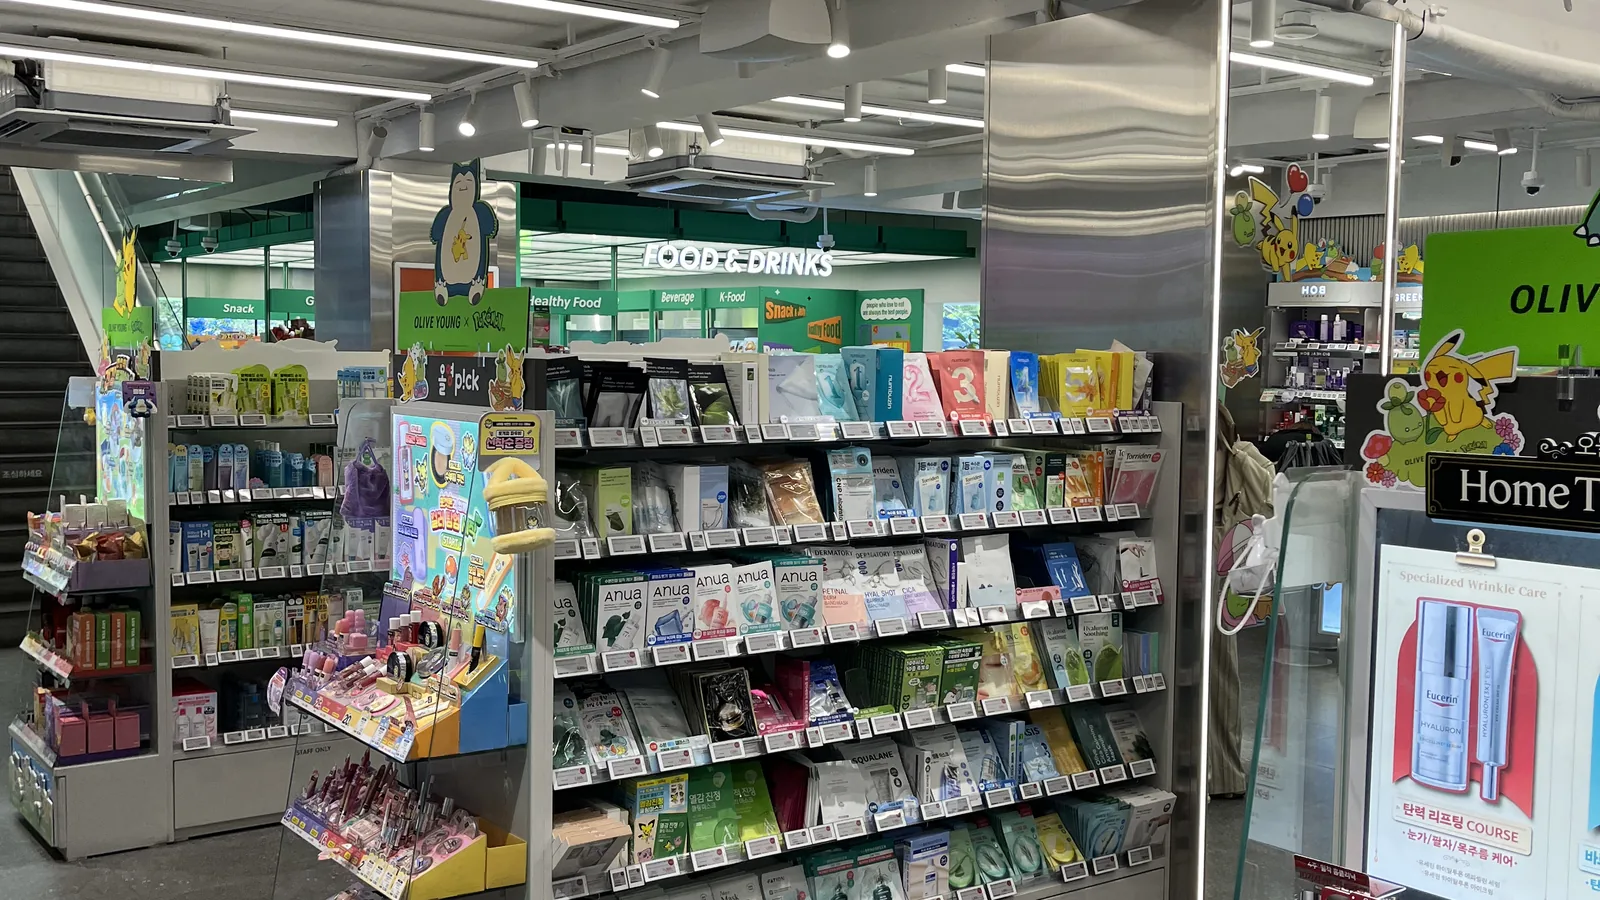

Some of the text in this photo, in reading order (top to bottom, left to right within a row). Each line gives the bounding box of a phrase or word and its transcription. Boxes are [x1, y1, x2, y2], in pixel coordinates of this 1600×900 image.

[643, 243, 833, 277] FOOD & DRINKS
[573, 297, 602, 309] Food
[661, 292, 695, 304] Beverage
[719, 291, 746, 302] K-Food
[223, 303, 254, 314] Snack
[765, 302, 793, 320] Snack
[414, 316, 434, 328] OLIVE
[436, 315, 461, 328] YOUNG
[823, 321, 841, 340] Food
[854, 367, 863, 391] 1
[952, 367, 977, 403] 3
[1126, 452, 1152, 460] Torriden
[1404, 455, 1424, 466] OLIVE
[2, 469, 43, 479] 조심하세요
[1460, 469, 1570, 510] Home
[200, 530, 210, 538] 1+1
[855, 550, 891, 559] DERMATORY
[696, 573, 730, 588] Anua
[737, 569, 770, 585] Anua
[781, 571, 818, 582] Anua
[653, 584, 690, 598] Anua
[1399, 570, 1547, 599] Specialized Wrinkle Care
[604, 588, 642, 602] Anua
[1482, 628, 1511, 641] Eucerin
[1426, 690, 1458, 705] Eucerin
[1420, 721, 1462, 735] HYALURON
[296, 746, 332, 756] STAFF ONLY
[852, 750, 894, 764] SQUALANE
[689, 790, 721, 806] 열감 진정
[1403, 802, 1519, 844] 탄력 리프팅 COURSE
[1407, 828, 1514, 867] 눈가/팔자/목주름 케어
[1418, 859, 1435, 870] 유세린
